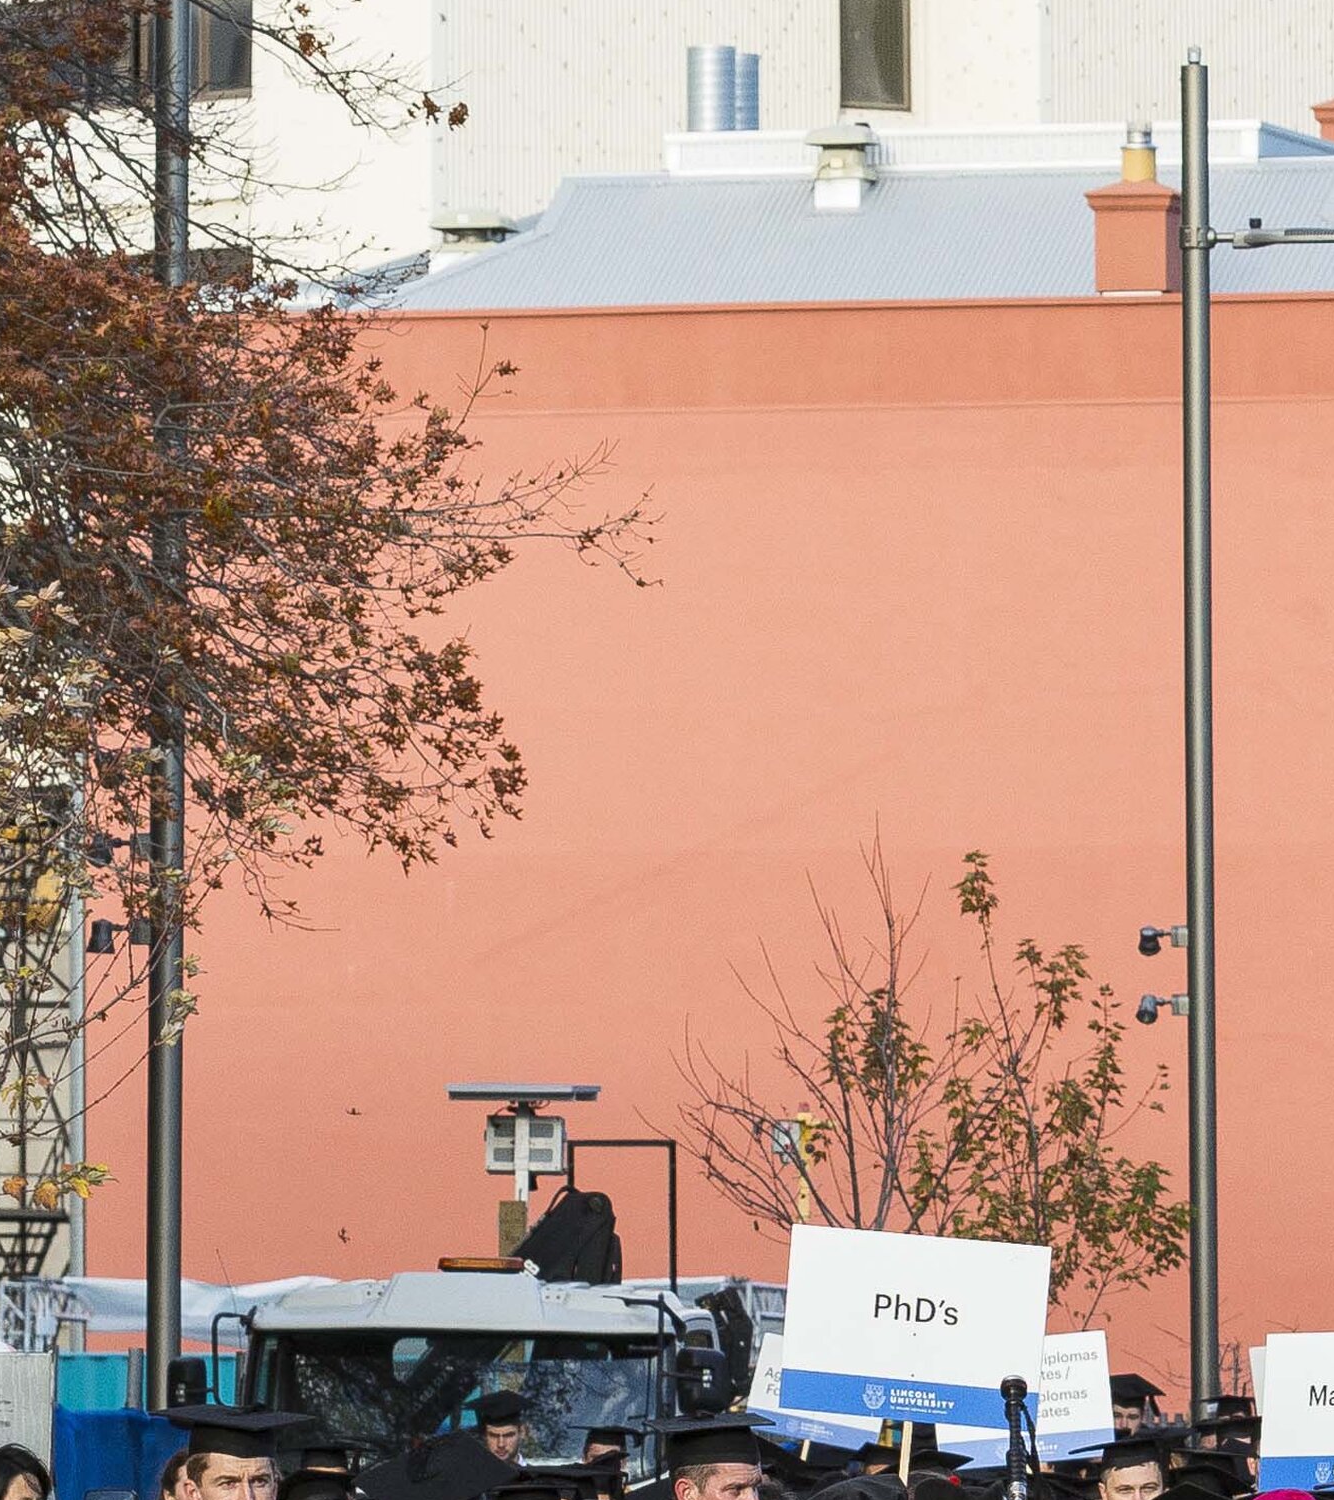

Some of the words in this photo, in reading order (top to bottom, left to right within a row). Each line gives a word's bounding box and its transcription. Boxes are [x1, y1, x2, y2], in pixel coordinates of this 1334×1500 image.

[873, 1293, 959, 1326] PhD's
[1043, 1350, 1099, 1367] iplomas
[890, 1388, 936, 1400] LINCOLN
[890, 1396, 955, 1410] UNIVERSITY
